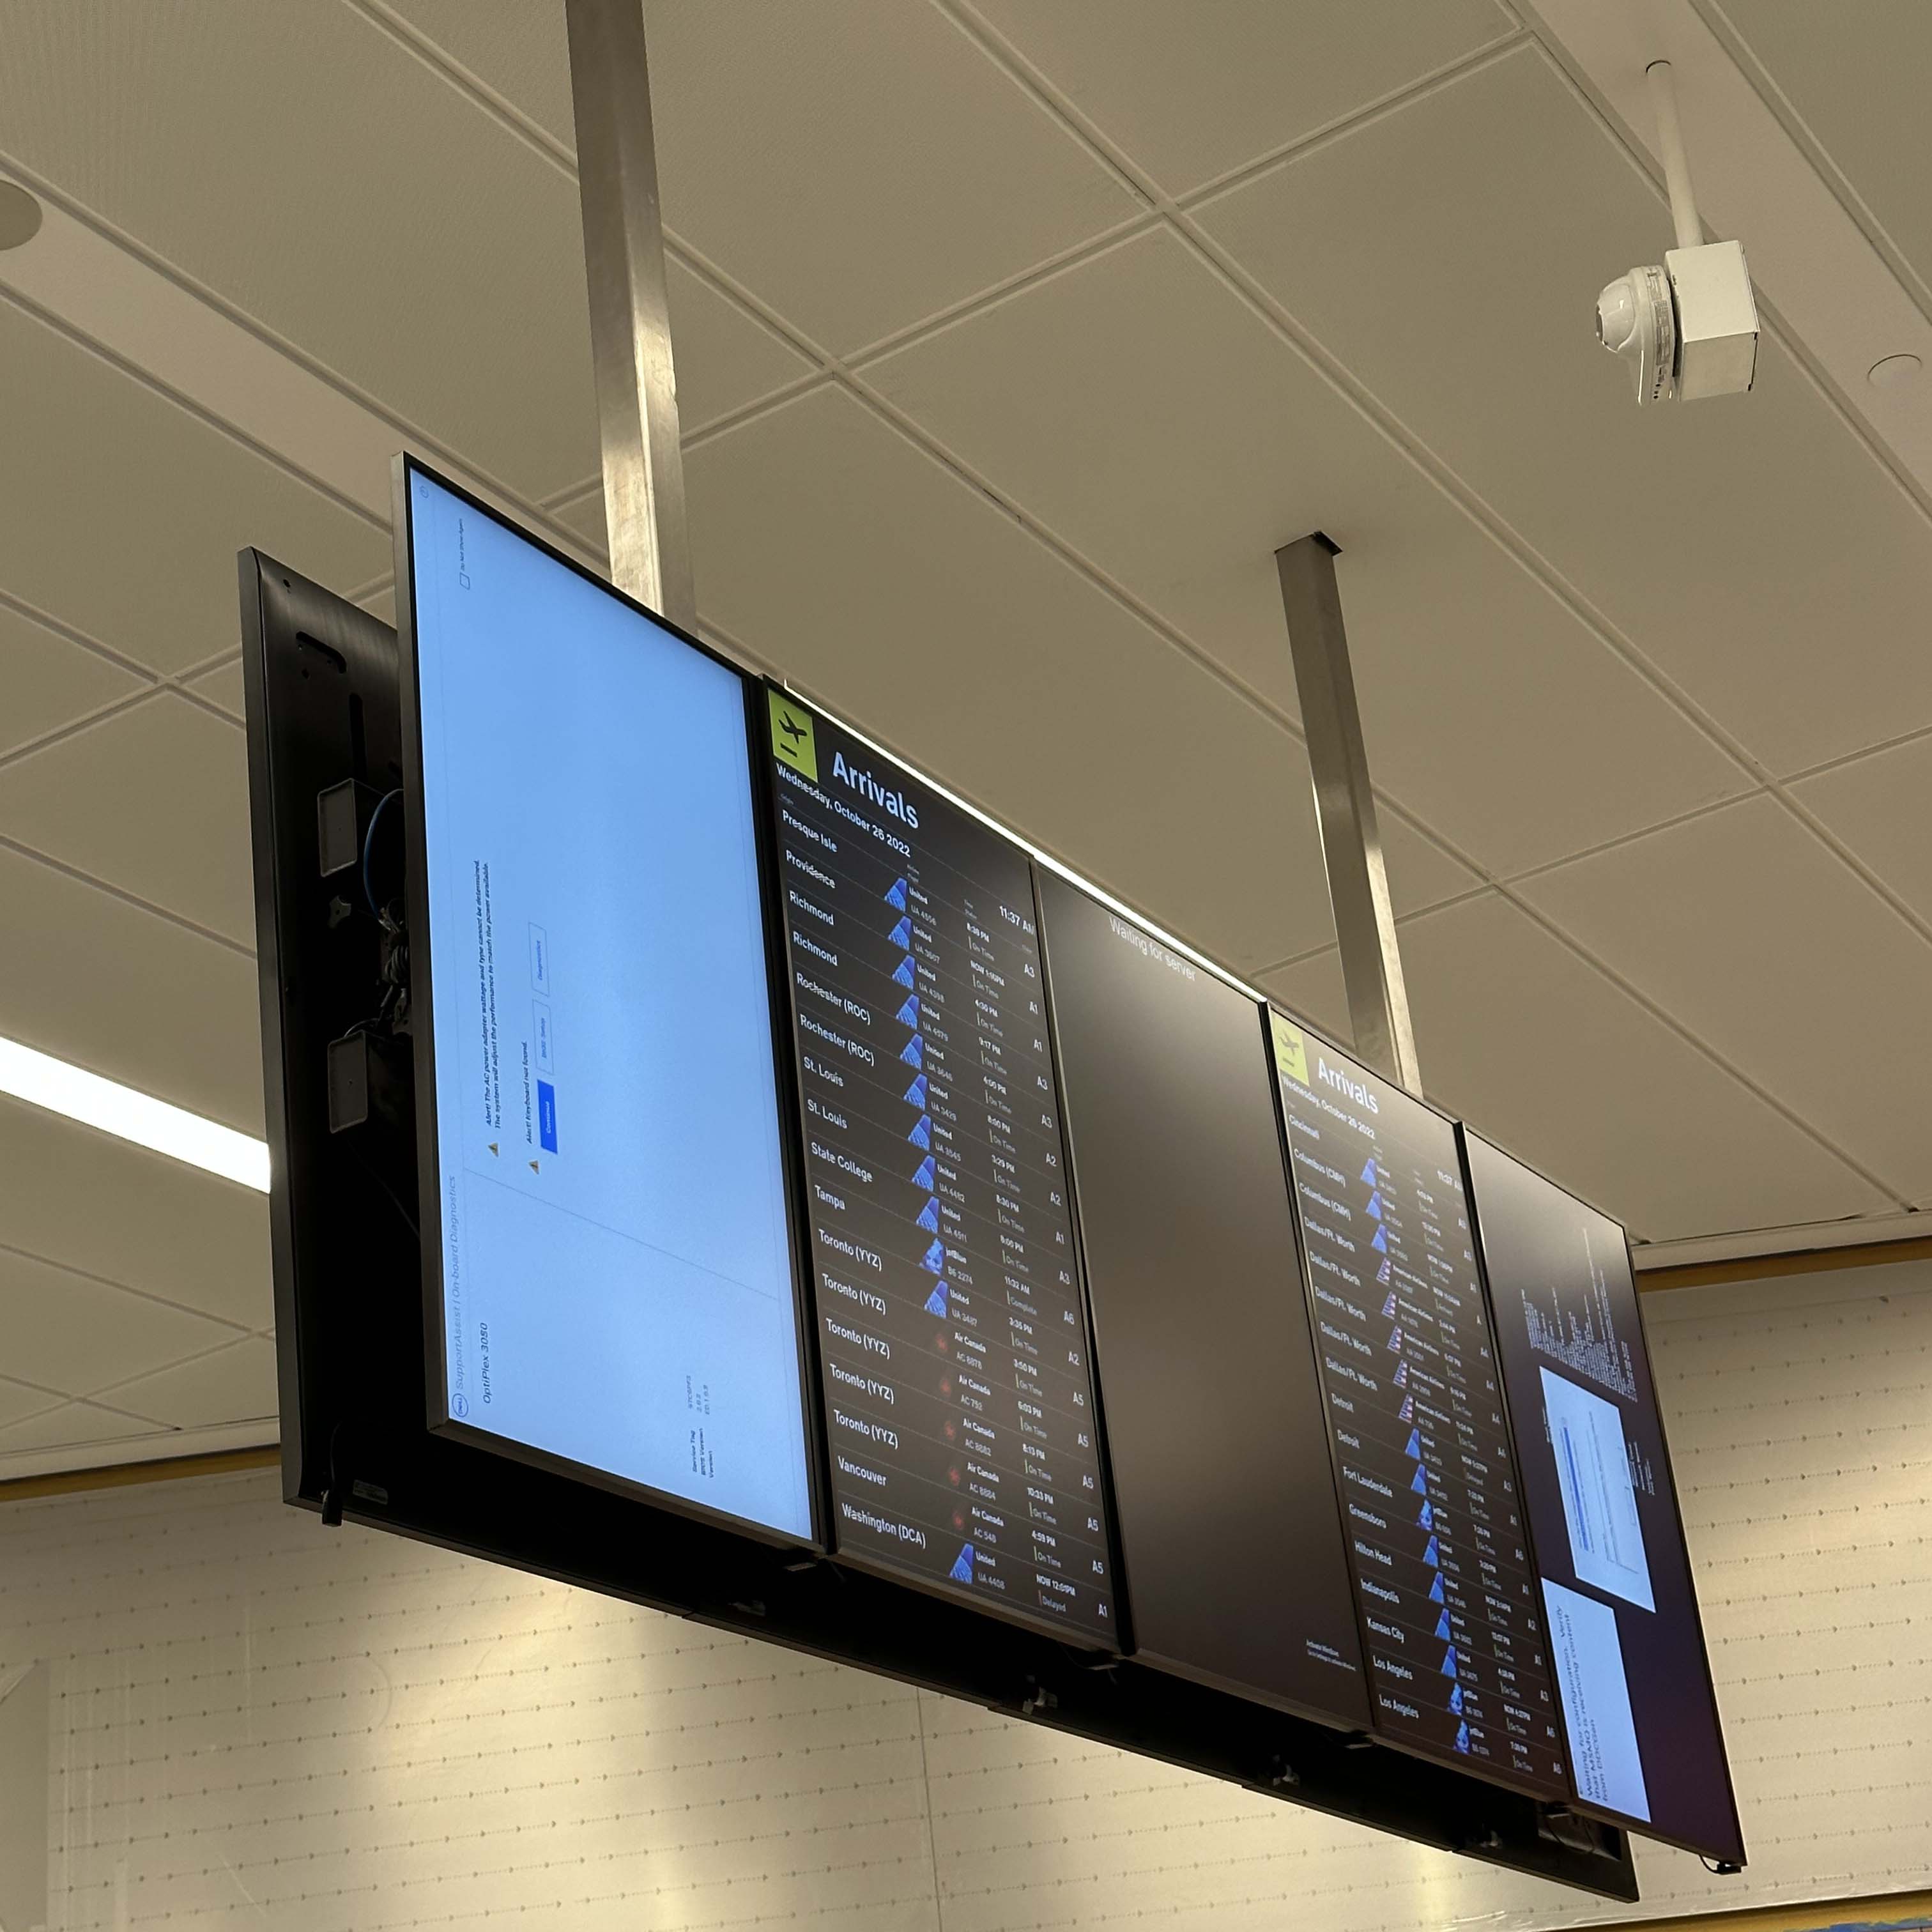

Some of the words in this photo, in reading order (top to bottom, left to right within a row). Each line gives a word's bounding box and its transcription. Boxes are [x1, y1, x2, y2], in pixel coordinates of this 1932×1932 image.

[833, 753, 918, 828] Arrivals
[776, 763, 832, 809] Wednesday,
[834, 801, 870, 831] October
[872, 825, 885, 841] 26
[887, 834, 910, 857] 2022
[783, 809, 819, 841] Presque
[820, 834, 837, 852] Isle
[786, 850, 835, 888] Providence
[909, 887, 928, 905] United
[790, 891, 834, 925] Richmond
[999, 906, 1020, 926] 11:37
[913, 926, 932, 943] United
[793, 931, 838, 966] Richmond
[1110, 918, 1147, 955] Waiting
[1149, 942, 1163, 962] for
[1165, 955, 1195, 981] server
[917, 964, 936, 981] United
[1024, 963, 1035, 977] A3
[797, 972, 841, 1007] Rochester
[844, 999, 870, 1025] (ROC)
[1029, 1001, 1038, 1015] A1
[921, 1004, 940, 1020] United
[800, 1014, 846, 1048] Rochester
[848, 1039, 874, 1066] (ROC)
[1034, 1039, 1043, 1052] A1
[925, 1043, 944, 1060] United
[804, 1056, 816, 1073] St.
[818, 1064, 843, 1087] Louis
[929, 1083, 948, 1100] United
[1037, 1076, 1048, 1090] A3
[1319, 1058, 1378, 1113] Arrivals
[808, 1099, 820, 1115] St.
[822, 1106, 847, 1129] Louis
[1282, 1075, 1321, 1108] Wednesday,
[1321, 1100, 1347, 1122] October
[1358, 1121, 1375, 1140] 2022
[1041, 1114, 1052, 1128] A3
[933, 1123, 953, 1140] United
[811, 1142, 836, 1163] State
[838, 1156, 872, 1182] College
[1046, 1153, 1057, 1167] A2
[937, 1164, 956, 1181] United
[815, 1184, 845, 1209] Tampa
[1050, 1192, 1061, 1206] A2
[449, 1176, 459, 1243] Diagnostics
[941, 1206, 961, 1222] United
[1055, 1231, 1064, 1245] A1
[818, 1229, 854, 1255] Toronto
[855, 1246, 882, 1271] (YYZ)
[1059, 1271, 1070, 1285] A3
[822, 1273, 858, 1300] Toronto
[859, 1290, 885, 1315] (YYZ)
[949, 1289, 969, 1305] United
[1064, 1310, 1075, 1325] A6
[454, 1307, 464, 1390] SupportAssist
[826, 1318, 862, 1344] Toronto
[863, 1334, 890, 1360] (YYZ)
[954, 1332, 963, 1342] Air
[964, 1336, 986, 1353] Canada
[1068, 1351, 1080, 1366] A2
[482, 1356, 492, 1404] OptiPlex
[830, 1363, 866, 1389] Toronto
[868, 1379, 894, 1404] (YYZ)
[959, 1375, 967, 1384] Air
[968, 1379, 991, 1395] Canada
[1073, 1392, 1084, 1406] A5
[834, 1409, 870, 1435] Toronto
[871, 1425, 898, 1449] (YYZ)
[963, 1418, 972, 1429] Air
[972, 1422, 995, 1439] Canada
[1078, 1433, 1089, 1447] A5
[838, 1456, 886, 1485] Vancouver
[967, 1462, 976, 1473] Air
[977, 1466, 999, 1482] Canada
[1082, 1475, 1094, 1489] A5
[842, 1503, 896, 1535] Washington
[898, 1524, 926, 1549] (DCA)
[972, 1506, 981, 1517] Air
[981, 1510, 1004, 1526] Canada
[1087, 1517, 1099, 1531] A5
[976, 1551, 995, 1567] United
[1092, 1560, 1103, 1574] A5
[1098, 1604, 1107, 1617] A1
